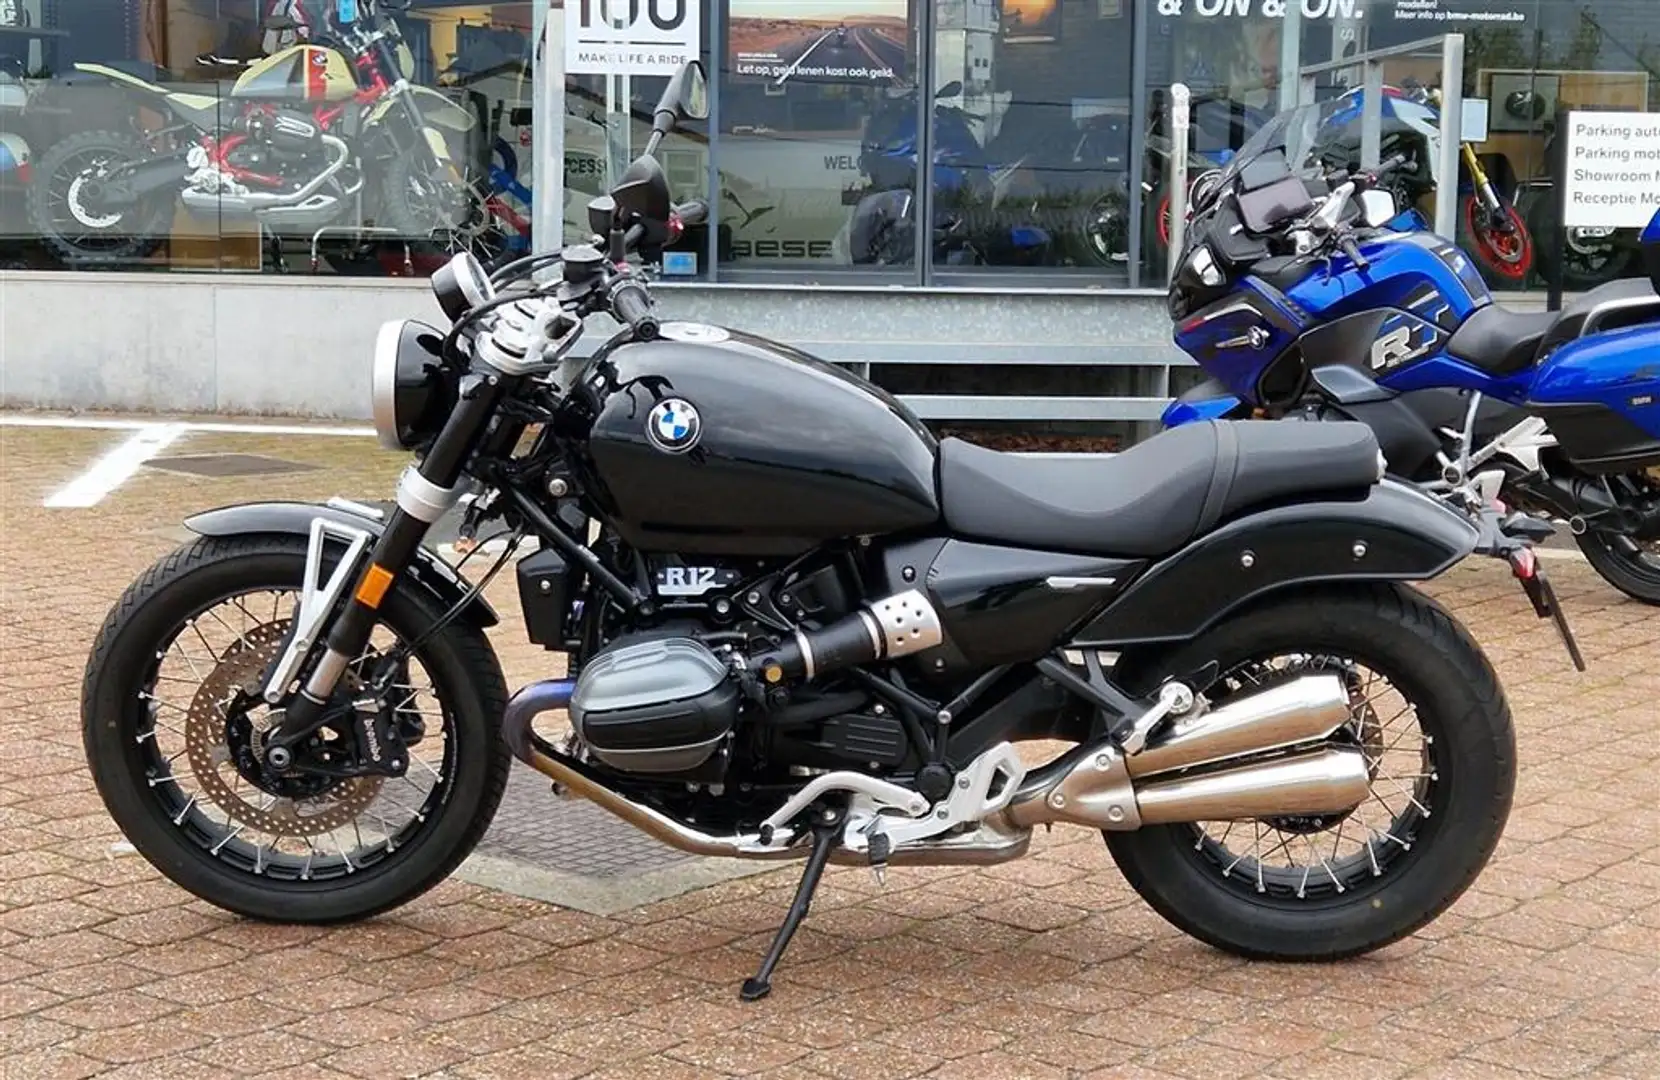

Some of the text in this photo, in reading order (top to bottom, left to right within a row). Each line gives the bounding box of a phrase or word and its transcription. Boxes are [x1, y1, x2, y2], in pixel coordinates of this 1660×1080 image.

[737, 63, 754, 75] Let
[755, 66, 772, 76] op,
[796, 65, 825, 76] lenen
[826, 66, 848, 76] kost
[849, 67, 868, 77] ook
[1576, 123, 1631, 140] Parking
[1575, 146, 1630, 162] Parking
[1574, 168, 1652, 181] Showroom
[1573, 191, 1636, 206] Receptie
[666, 567, 716, 586] R12
[364, 718, 381, 762] brembo
